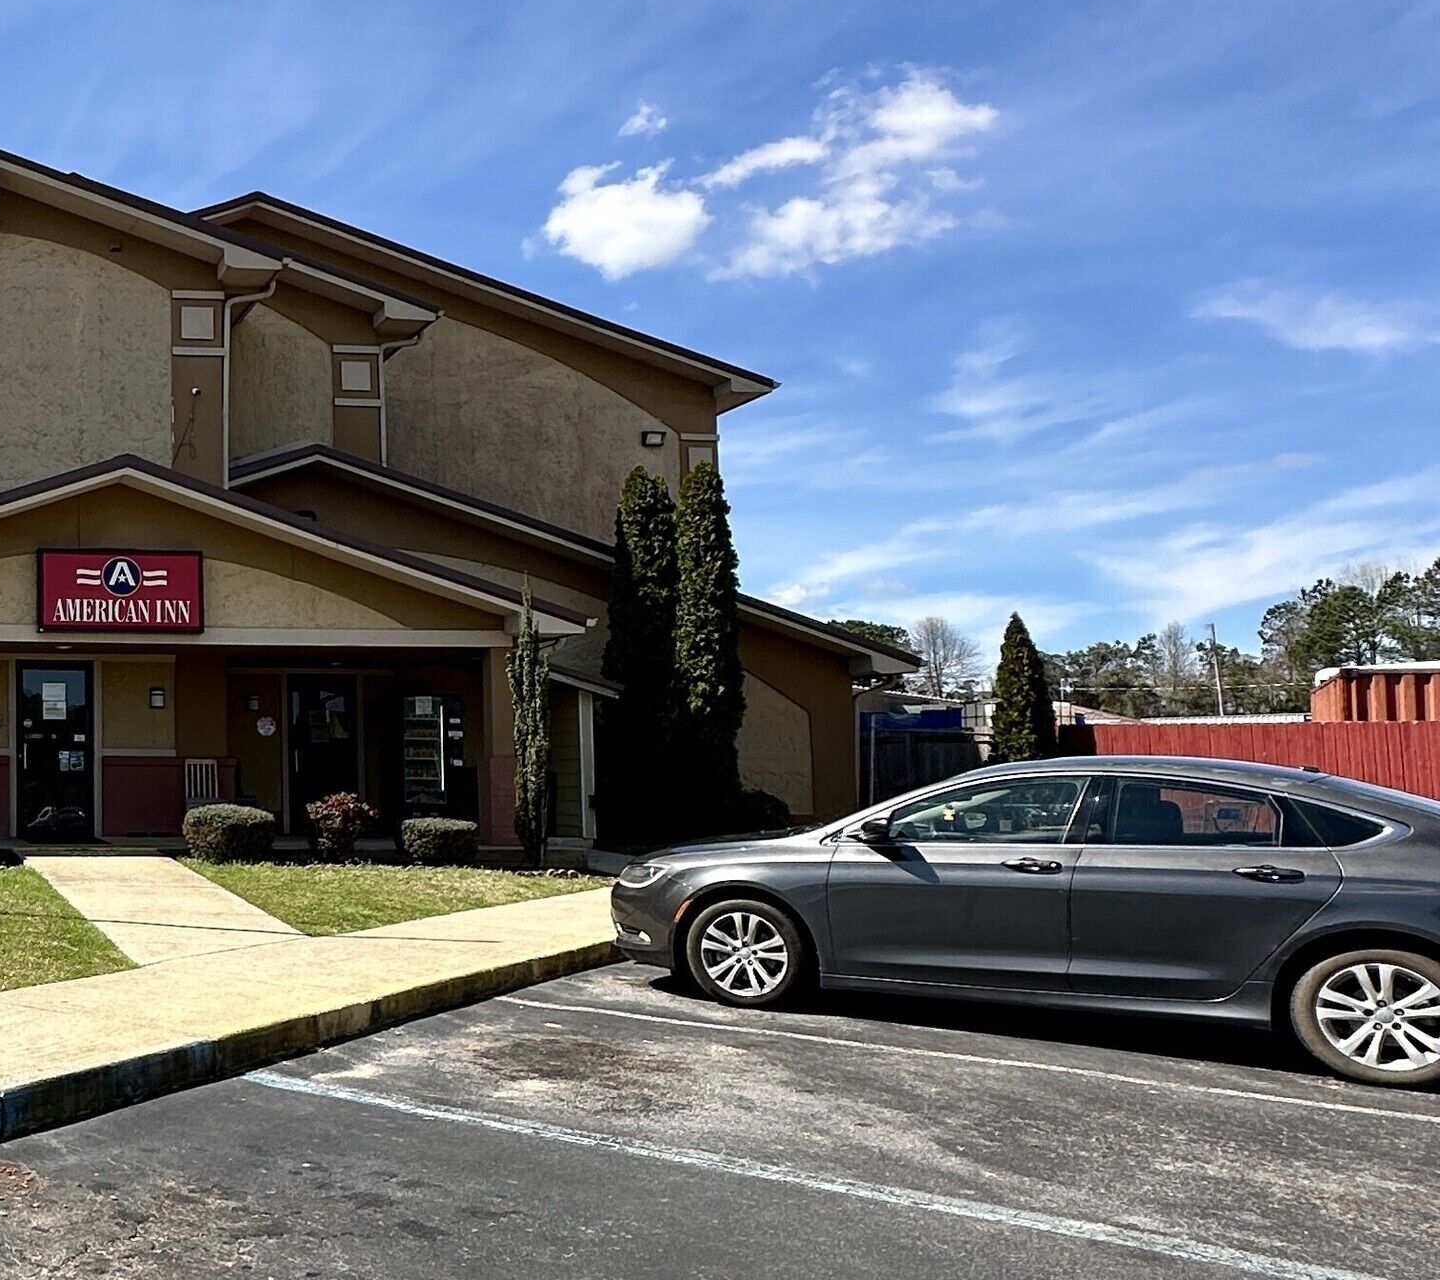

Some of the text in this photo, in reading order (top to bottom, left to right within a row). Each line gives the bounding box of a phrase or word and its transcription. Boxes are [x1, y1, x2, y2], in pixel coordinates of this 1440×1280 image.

[109, 561, 136, 586] A
[53, 598, 191, 624] AMERICAN INN
